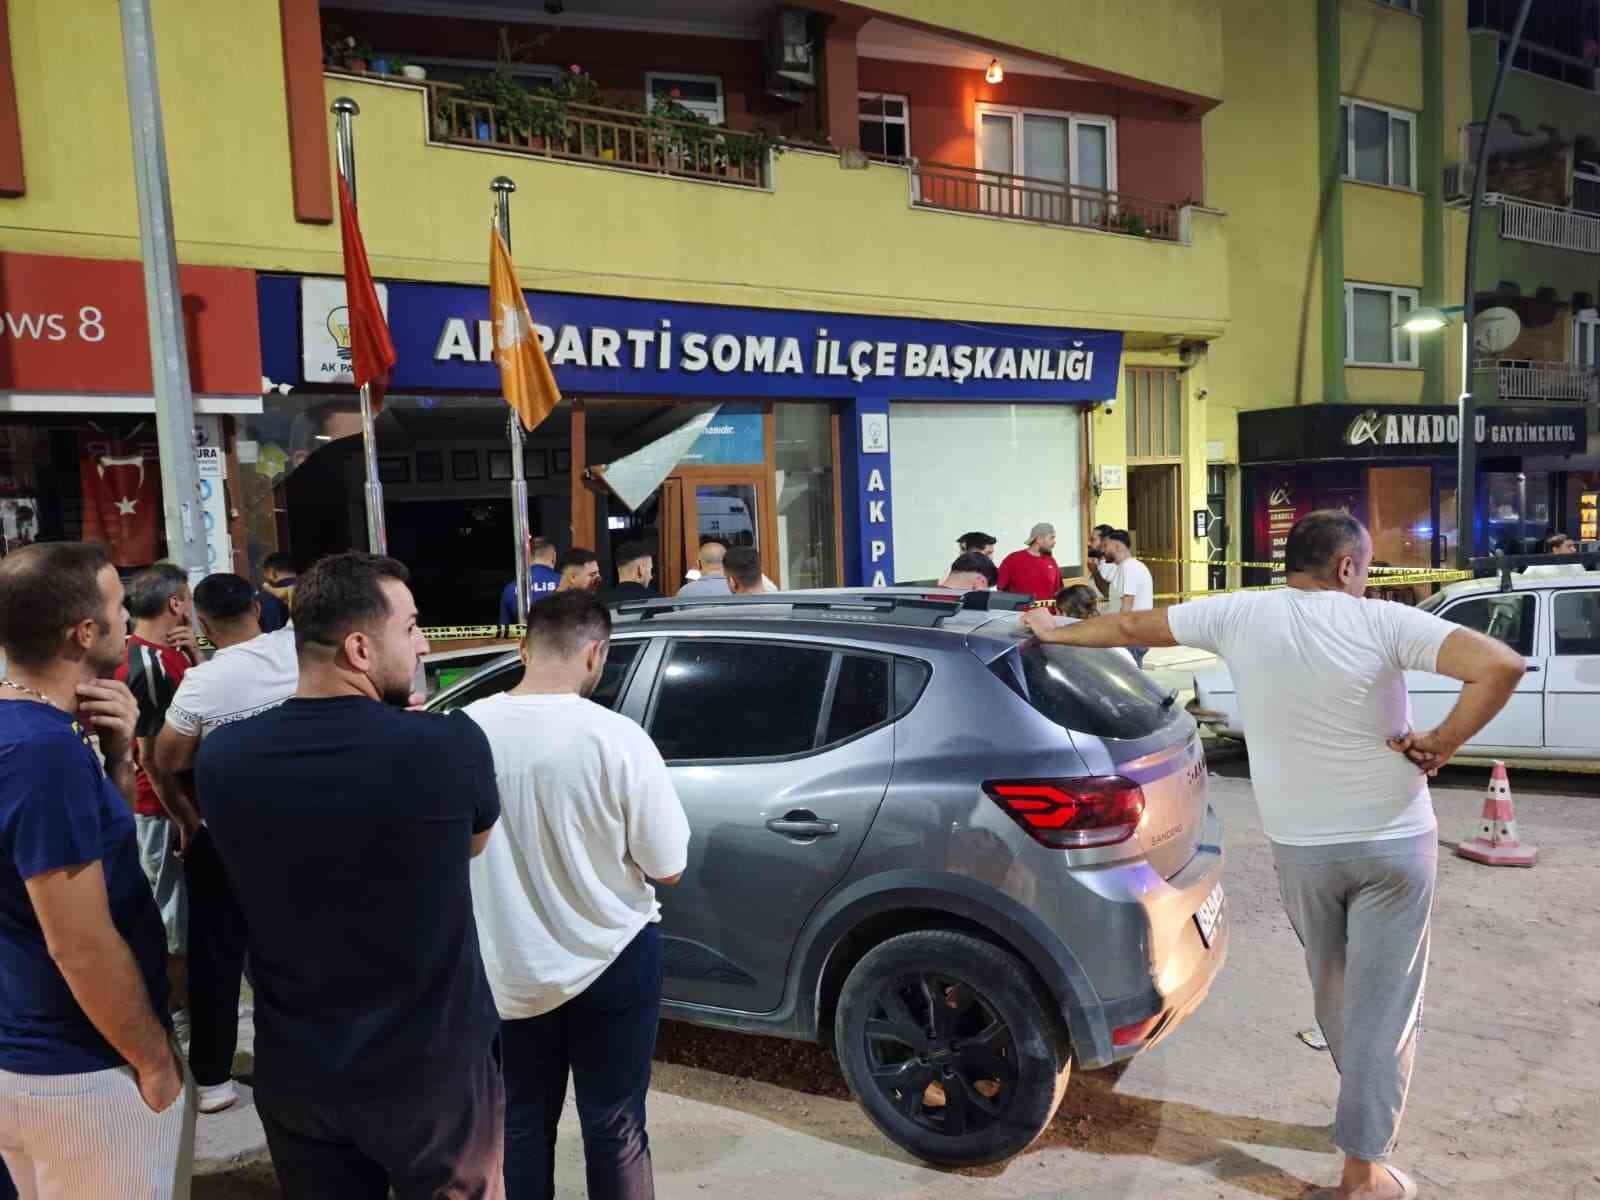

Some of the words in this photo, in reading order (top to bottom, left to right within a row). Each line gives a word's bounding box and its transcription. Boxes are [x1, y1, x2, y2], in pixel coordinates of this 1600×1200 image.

[79, 306, 104, 341] 8
[320, 362, 336, 372] AK
[340, 363, 353, 373] PA
[680, 333, 803, 374] SOMA
[814, 328, 897, 383] İLÇE
[904, 341, 1093, 384] BAŞKANLIĞI
[1385, 414, 1485, 444] ANADOU
[871, 540, 887, 587] PA
